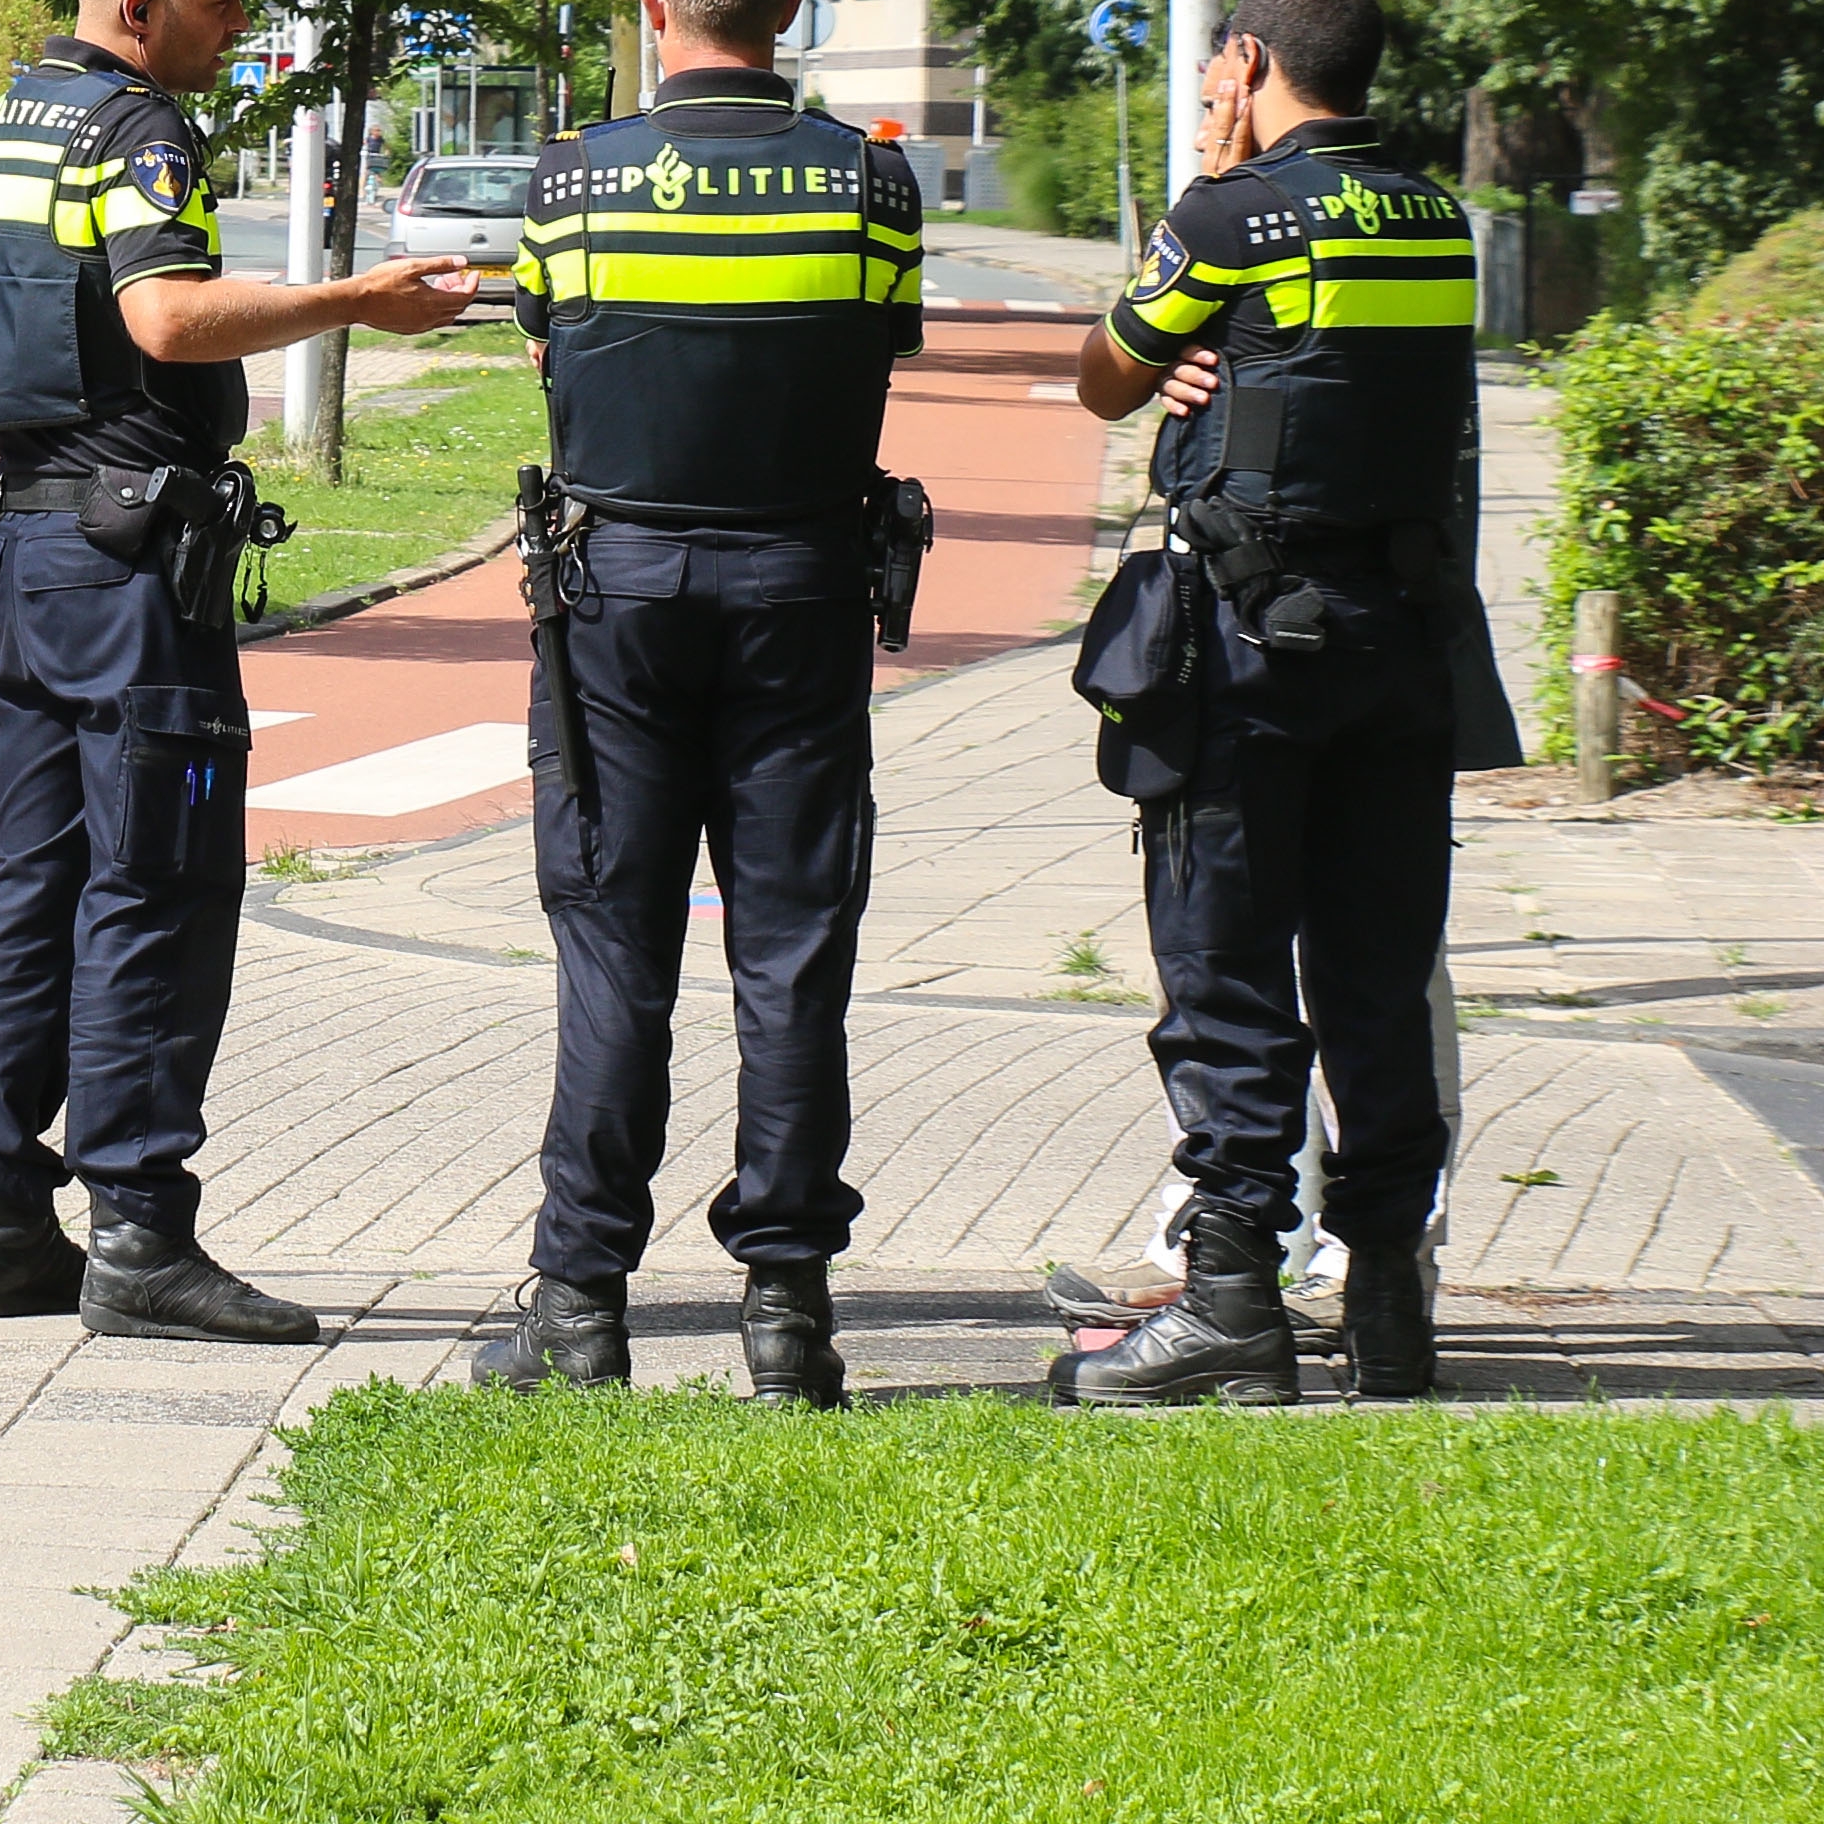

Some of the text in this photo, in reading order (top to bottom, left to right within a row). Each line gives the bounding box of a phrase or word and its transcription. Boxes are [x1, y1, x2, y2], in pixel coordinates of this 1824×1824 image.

[135, 148, 186, 168] POLITIE
[621, 142, 829, 211] POLITIE
[1320, 173, 1457, 235] POLITIE
